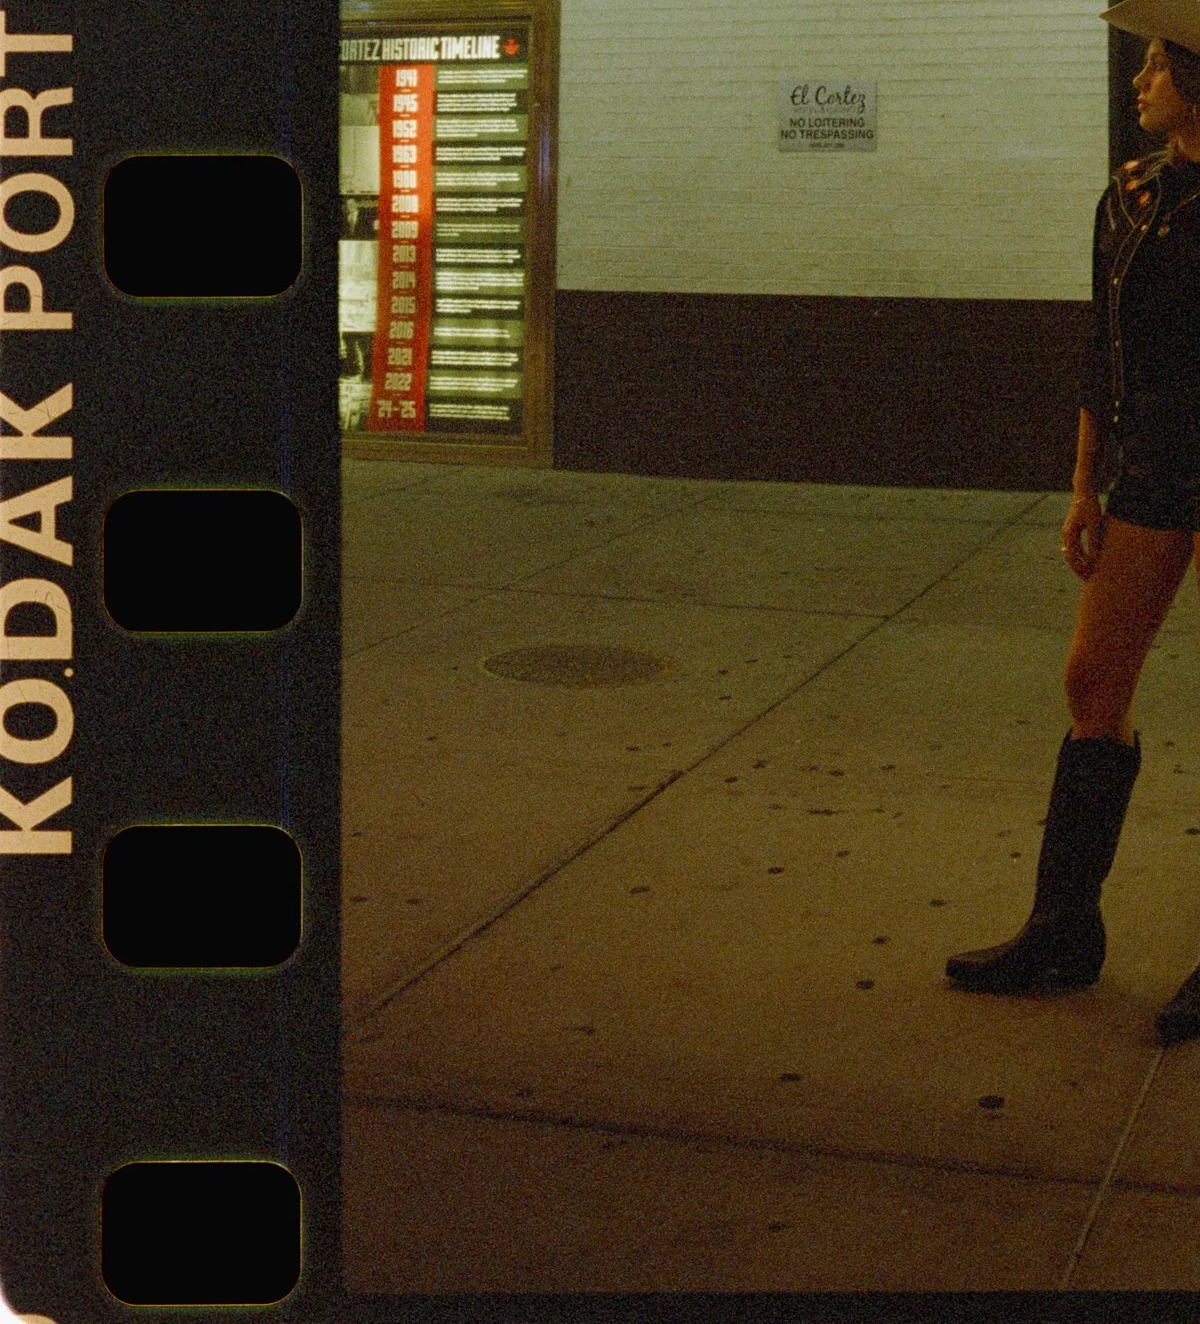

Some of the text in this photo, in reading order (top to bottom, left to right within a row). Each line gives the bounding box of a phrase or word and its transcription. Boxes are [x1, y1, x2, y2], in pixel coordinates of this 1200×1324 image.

[338, 35, 500, 61] ORTEZ HISTORIC TIMELINE
[790, 84, 866, 114] El Cortez
[790, 117, 865, 128] NO LOITERING
[780, 129, 874, 140] NO TRESPASSING
